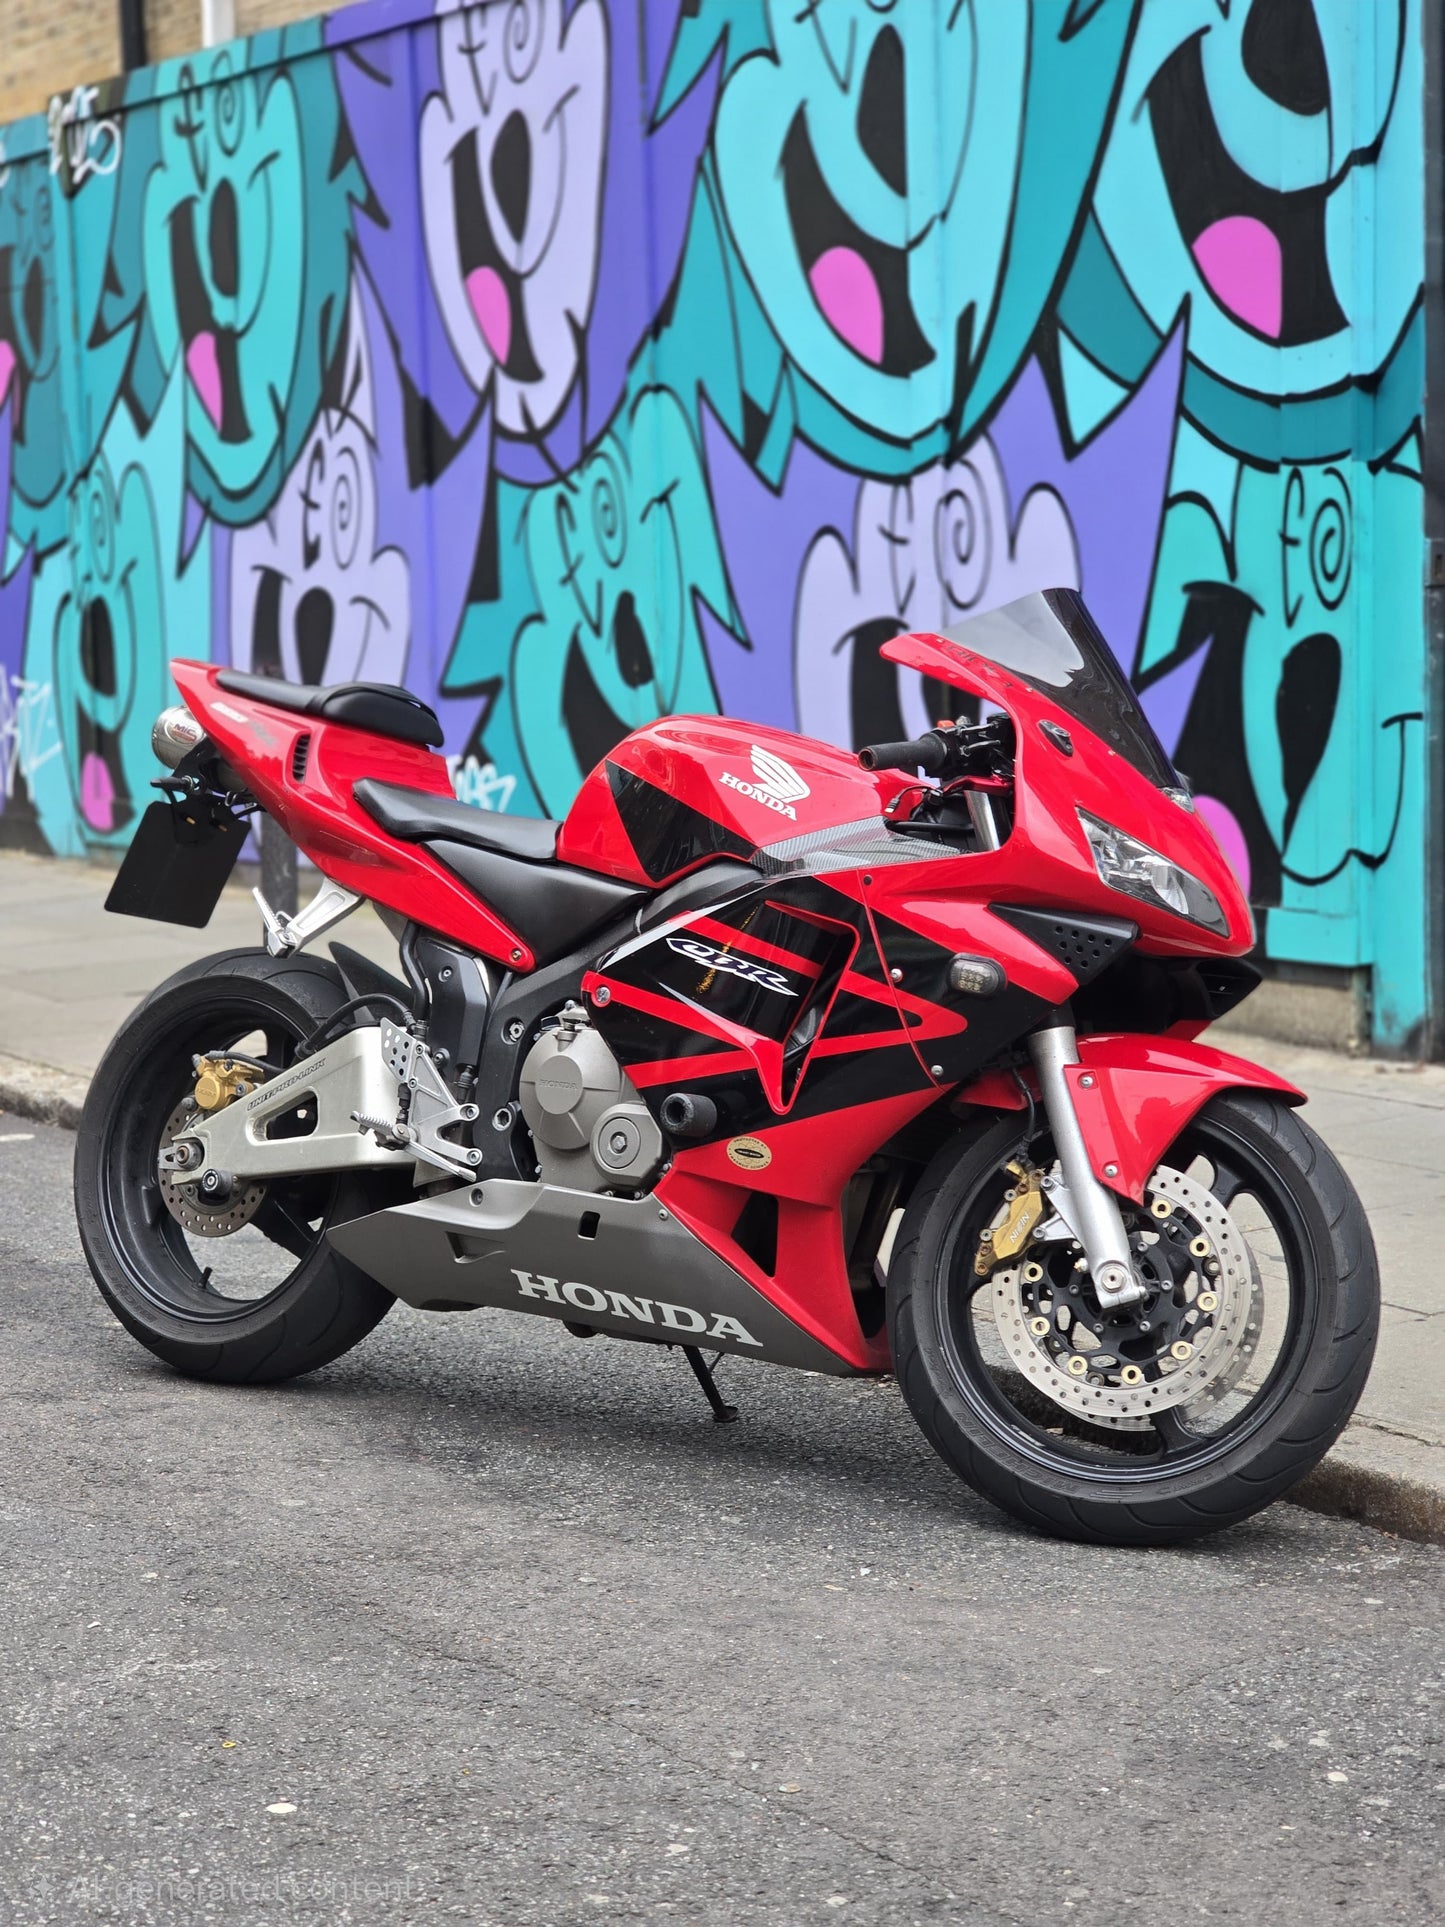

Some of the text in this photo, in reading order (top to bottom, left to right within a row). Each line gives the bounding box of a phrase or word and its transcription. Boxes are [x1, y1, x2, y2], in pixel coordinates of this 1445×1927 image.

[718, 771, 797, 821] HONDA
[510, 1268, 764, 1347] HONDA
[954, 1411, 1082, 1494] MICHELIN
